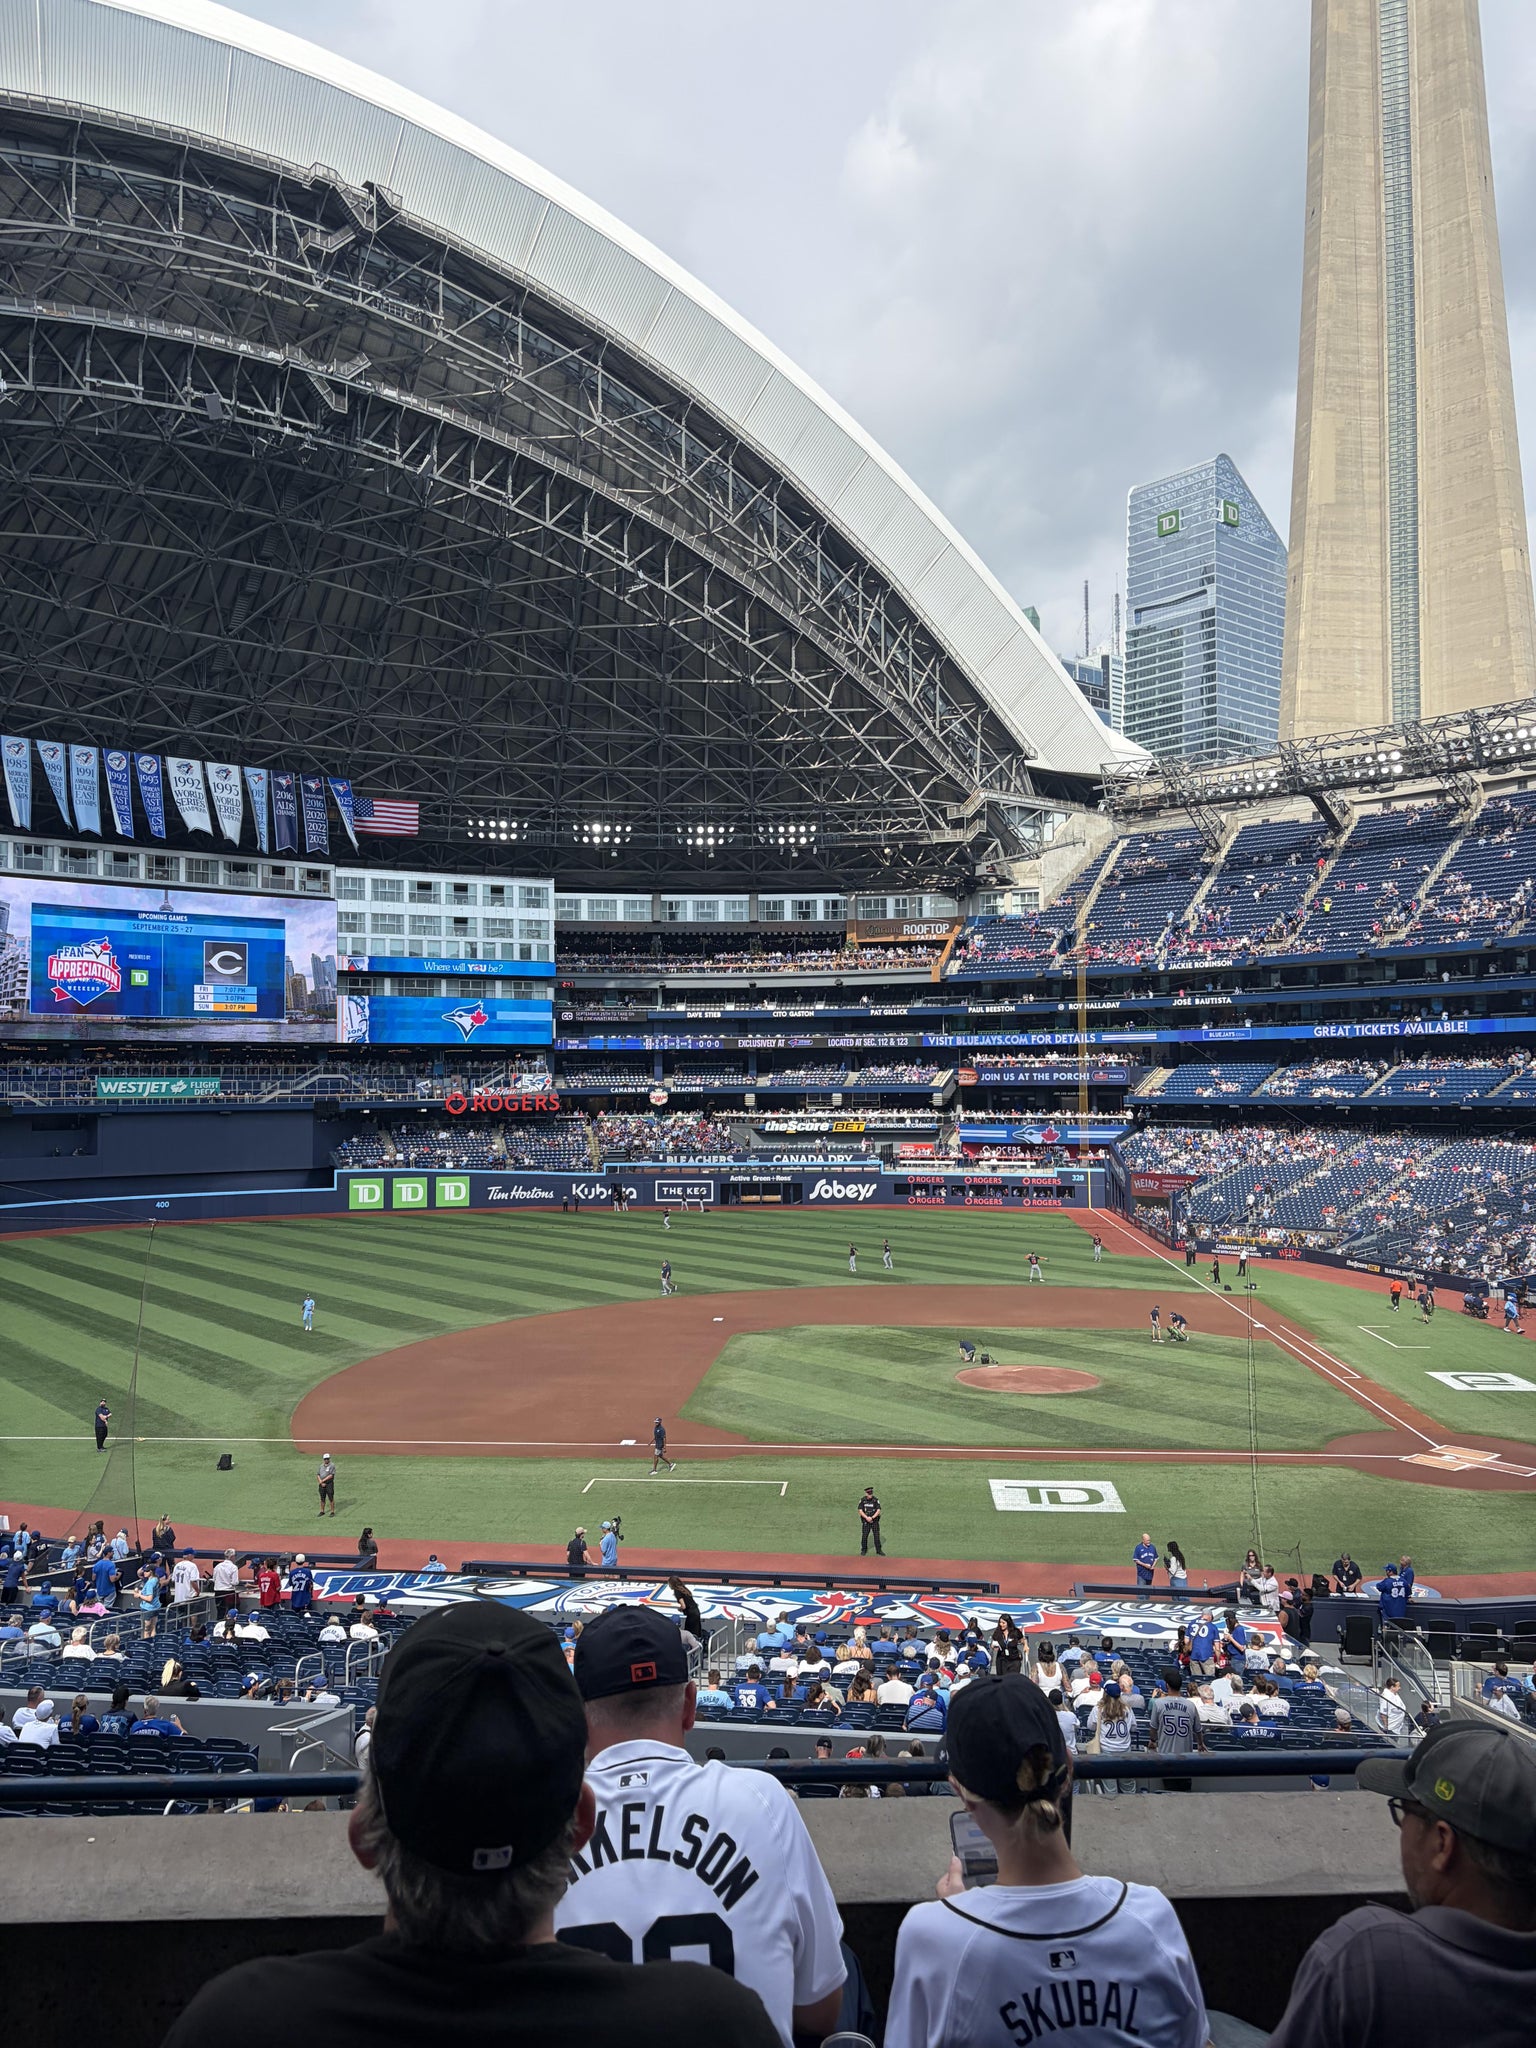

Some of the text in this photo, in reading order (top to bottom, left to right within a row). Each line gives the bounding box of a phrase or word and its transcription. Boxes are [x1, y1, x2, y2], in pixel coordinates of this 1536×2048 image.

[1226, 504, 1239, 522] TD
[1159, 515, 1176, 531] TD
[6, 758, 28, 770] 1985
[45, 763, 62, 774] 989
[76, 767, 94, 778] 1991
[109, 771, 127, 783] 1992
[140, 774, 159, 785] 1993
[174, 776, 202, 790] 1992
[75, 790, 96, 801] EAST
[174, 789, 204, 801] WORLD
[213, 782, 240, 799] 1993
[275, 790, 294, 801] 2016
[176, 798, 206, 809] SERIES
[306, 798, 324, 808] 2016
[338, 796, 353, 805] 025
[218, 804, 241, 817] ERIES
[306, 810, 326, 820] 2020
[307, 822, 327, 833] 2022
[308, 834, 327, 845] 2023
[138, 913, 188, 923] UPCOMING GAMES
[132, 923, 193, 934] SEPTEMBER 25 27
[903, 923, 950, 935] ROOFTOP
[63, 946, 85, 957] FAN
[423, 962, 504, 973] Where will YOU be?
[1168, 960, 1233, 970] JACKIE ROBINSON
[51, 960, 119, 986] APPRECIATION
[132, 972, 147, 983] TD
[1084, 1001, 1121, 1010] HALLADAY
[1172, 997, 1232, 1006] JOSÉ BAUTISTA
[883, 1008, 908, 1016] GILLICK
[968, 1005, 1016, 1014] PAUL BEESTON
[1313, 1021, 1468, 1037] GREAT TICKETS AVAILABLE!
[738, 1039, 776, 1048] EXCLUSIVELY
[777, 1039, 785, 1047] AT
[828, 1037, 909, 1047] LOCATED AT SEC. 112 & 123
[928, 1033, 1096, 1045] VISIT BLUEJAYS.COM FOR DETAILS
[981, 1073, 1002, 1081] JOIN
[1003, 1073, 1015, 1081] US
[1018, 1073, 1030, 1081] AT
[1032, 1073, 1050, 1081] THE
[1053, 1072, 1090, 1081] PORCH!
[100, 1081, 220, 1097] WESTJET FLIGHT
[194, 1088, 214, 1096] DECK
[473, 1093, 561, 1112] ROGERS
[764, 1121, 830, 1134] theScore
[834, 1122, 864, 1131] BET
[996, 1146, 1021, 1154] OGERS
[666, 1155, 735, 1163] BLEACHERS
[773, 1154, 853, 1163] CANADA DRY
[809, 1178, 877, 1201] Sobeys
[1134, 1178, 1160, 1190] HEINZ
[352, 1184, 381, 1203] TD
[396, 1183, 424, 1202] TD
[439, 1182, 467, 1201] TD
[487, 1185, 555, 1201] Tim Hortons
[662, 1187, 683, 1195] THE
[155, 1201, 170, 1209] 400
[1278, 1248, 1302, 1259] HEINZ
[1004, 1485, 1105, 1505] TD
[175, 1573, 185, 1584] 11
[260, 1582, 270, 1593] 17
[292, 1580, 305, 1591] 27
[1391, 1587, 1405, 1598] 84
[1190, 1624, 1209, 1637] 30
[738, 1694, 757, 1708] 39
[1164, 1702, 1188, 1714] MARTIN
[102, 1722, 120, 1733] 23
[1103, 1719, 1128, 1739] 20
[1163, 1714, 1190, 1737] 55
[566, 1802, 761, 1913] KELSON
[999, 1979, 1140, 2047] SKUBAL
